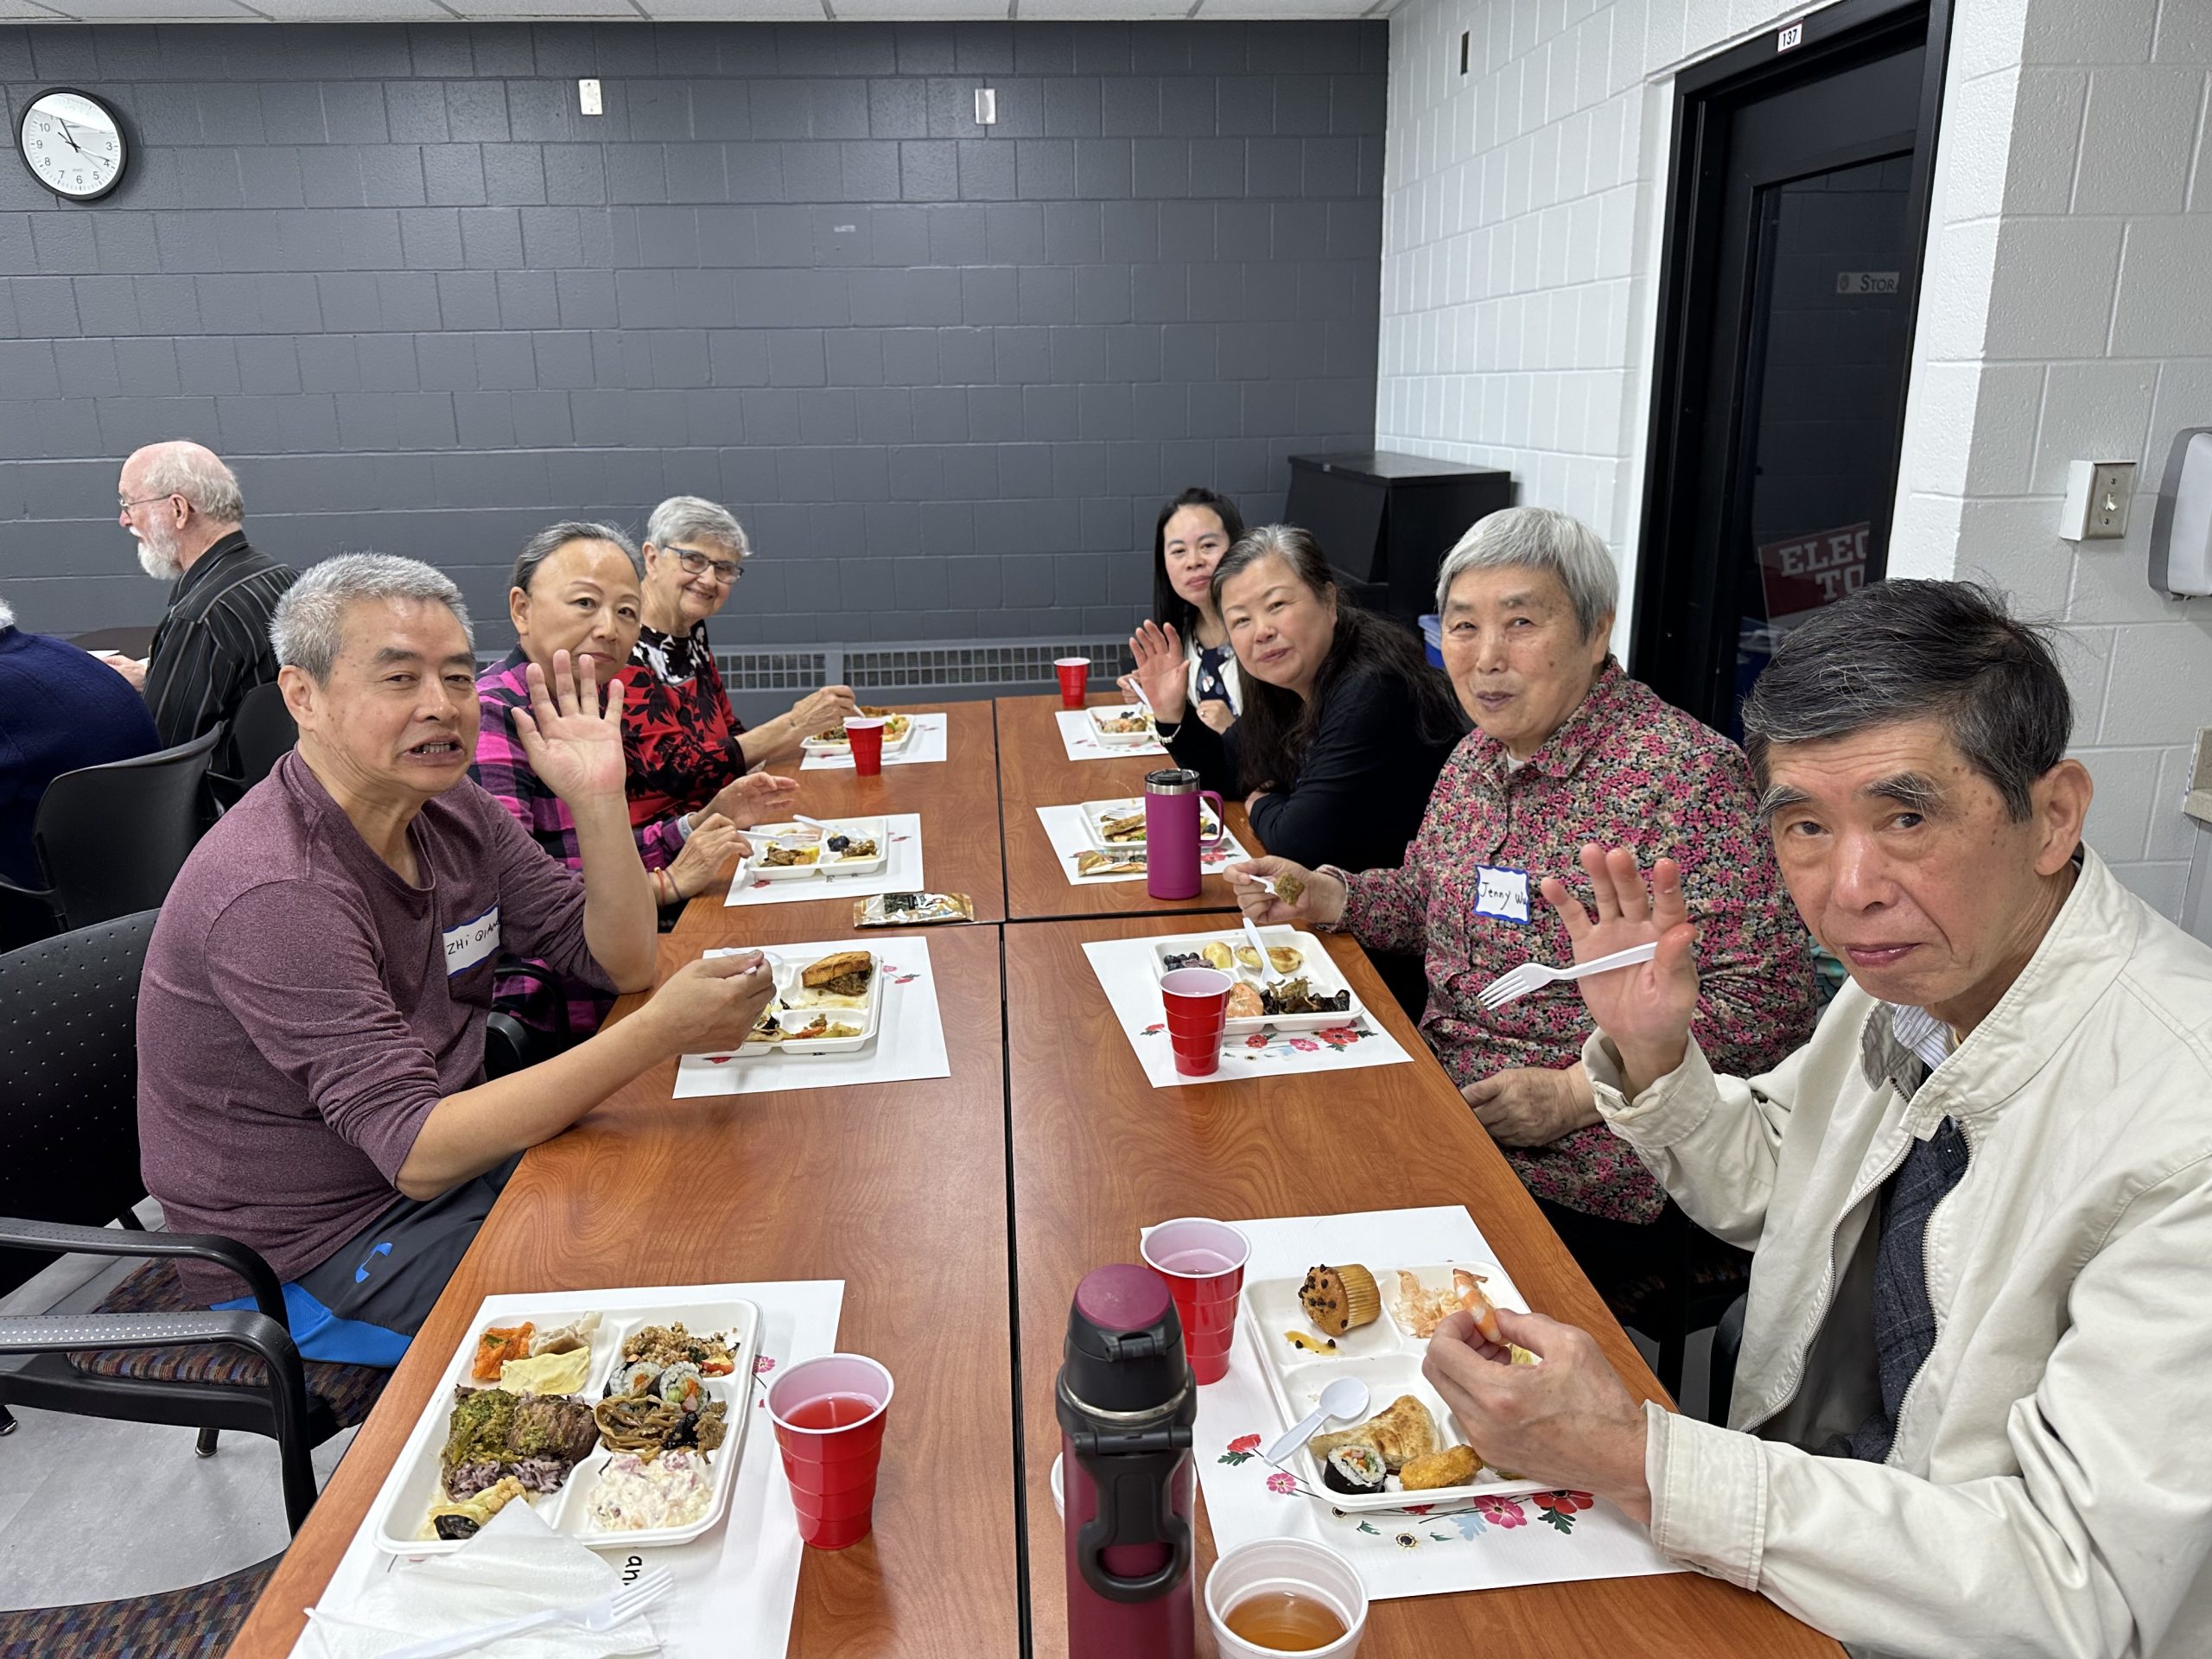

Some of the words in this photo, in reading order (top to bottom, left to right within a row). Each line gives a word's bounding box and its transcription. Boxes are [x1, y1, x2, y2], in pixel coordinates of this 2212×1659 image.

[1783, 28, 1798, 48] 137
[39, 123, 50, 132] 10
[35, 139, 43, 149] 9
[105, 142, 113, 150] 3
[44, 156, 51, 167] 8
[58, 169, 65, 180] 7
[92, 171, 99, 181] 5
[76, 175, 83, 185] 6
[1479, 881, 1511, 911] Jenny
